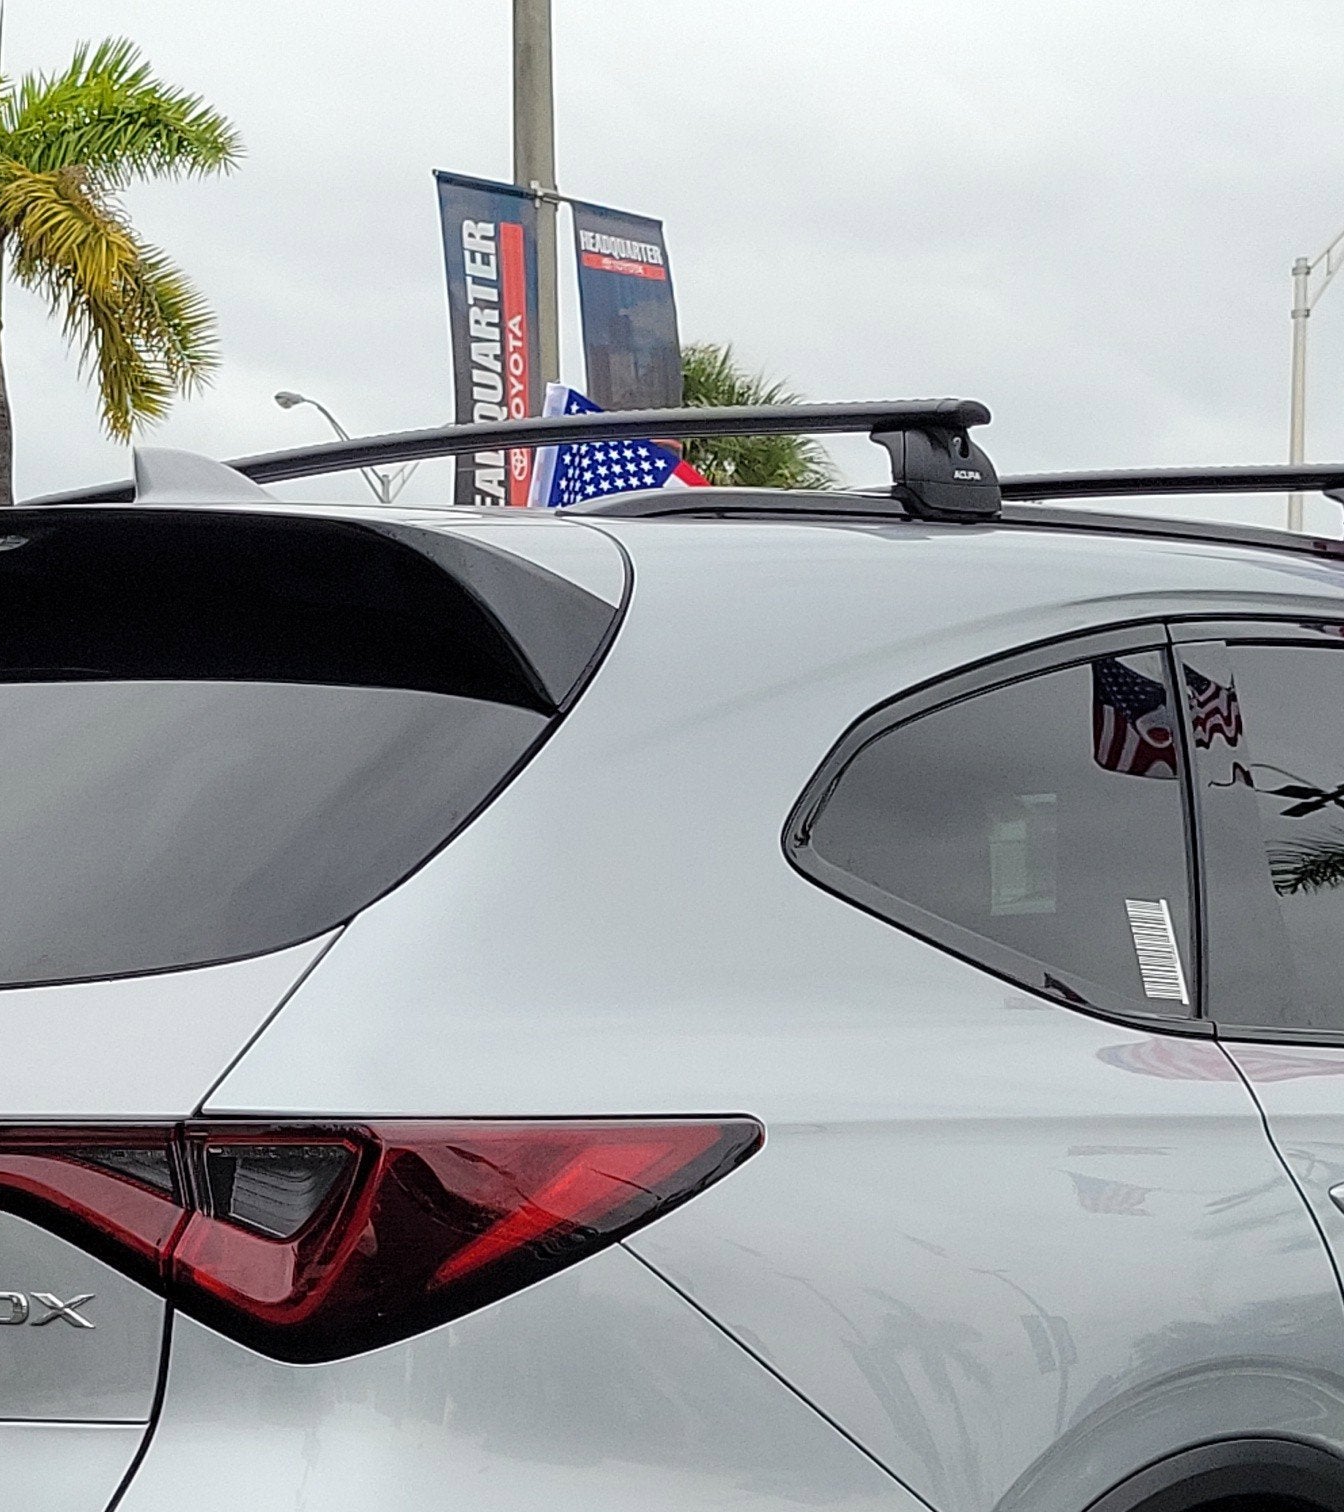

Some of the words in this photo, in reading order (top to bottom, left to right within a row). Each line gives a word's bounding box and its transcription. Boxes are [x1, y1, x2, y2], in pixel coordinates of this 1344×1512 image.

[462, 219, 507, 507] AQUARTER
[506, 315, 525, 420] OYOTA
[954, 470, 982, 480] ACURA
